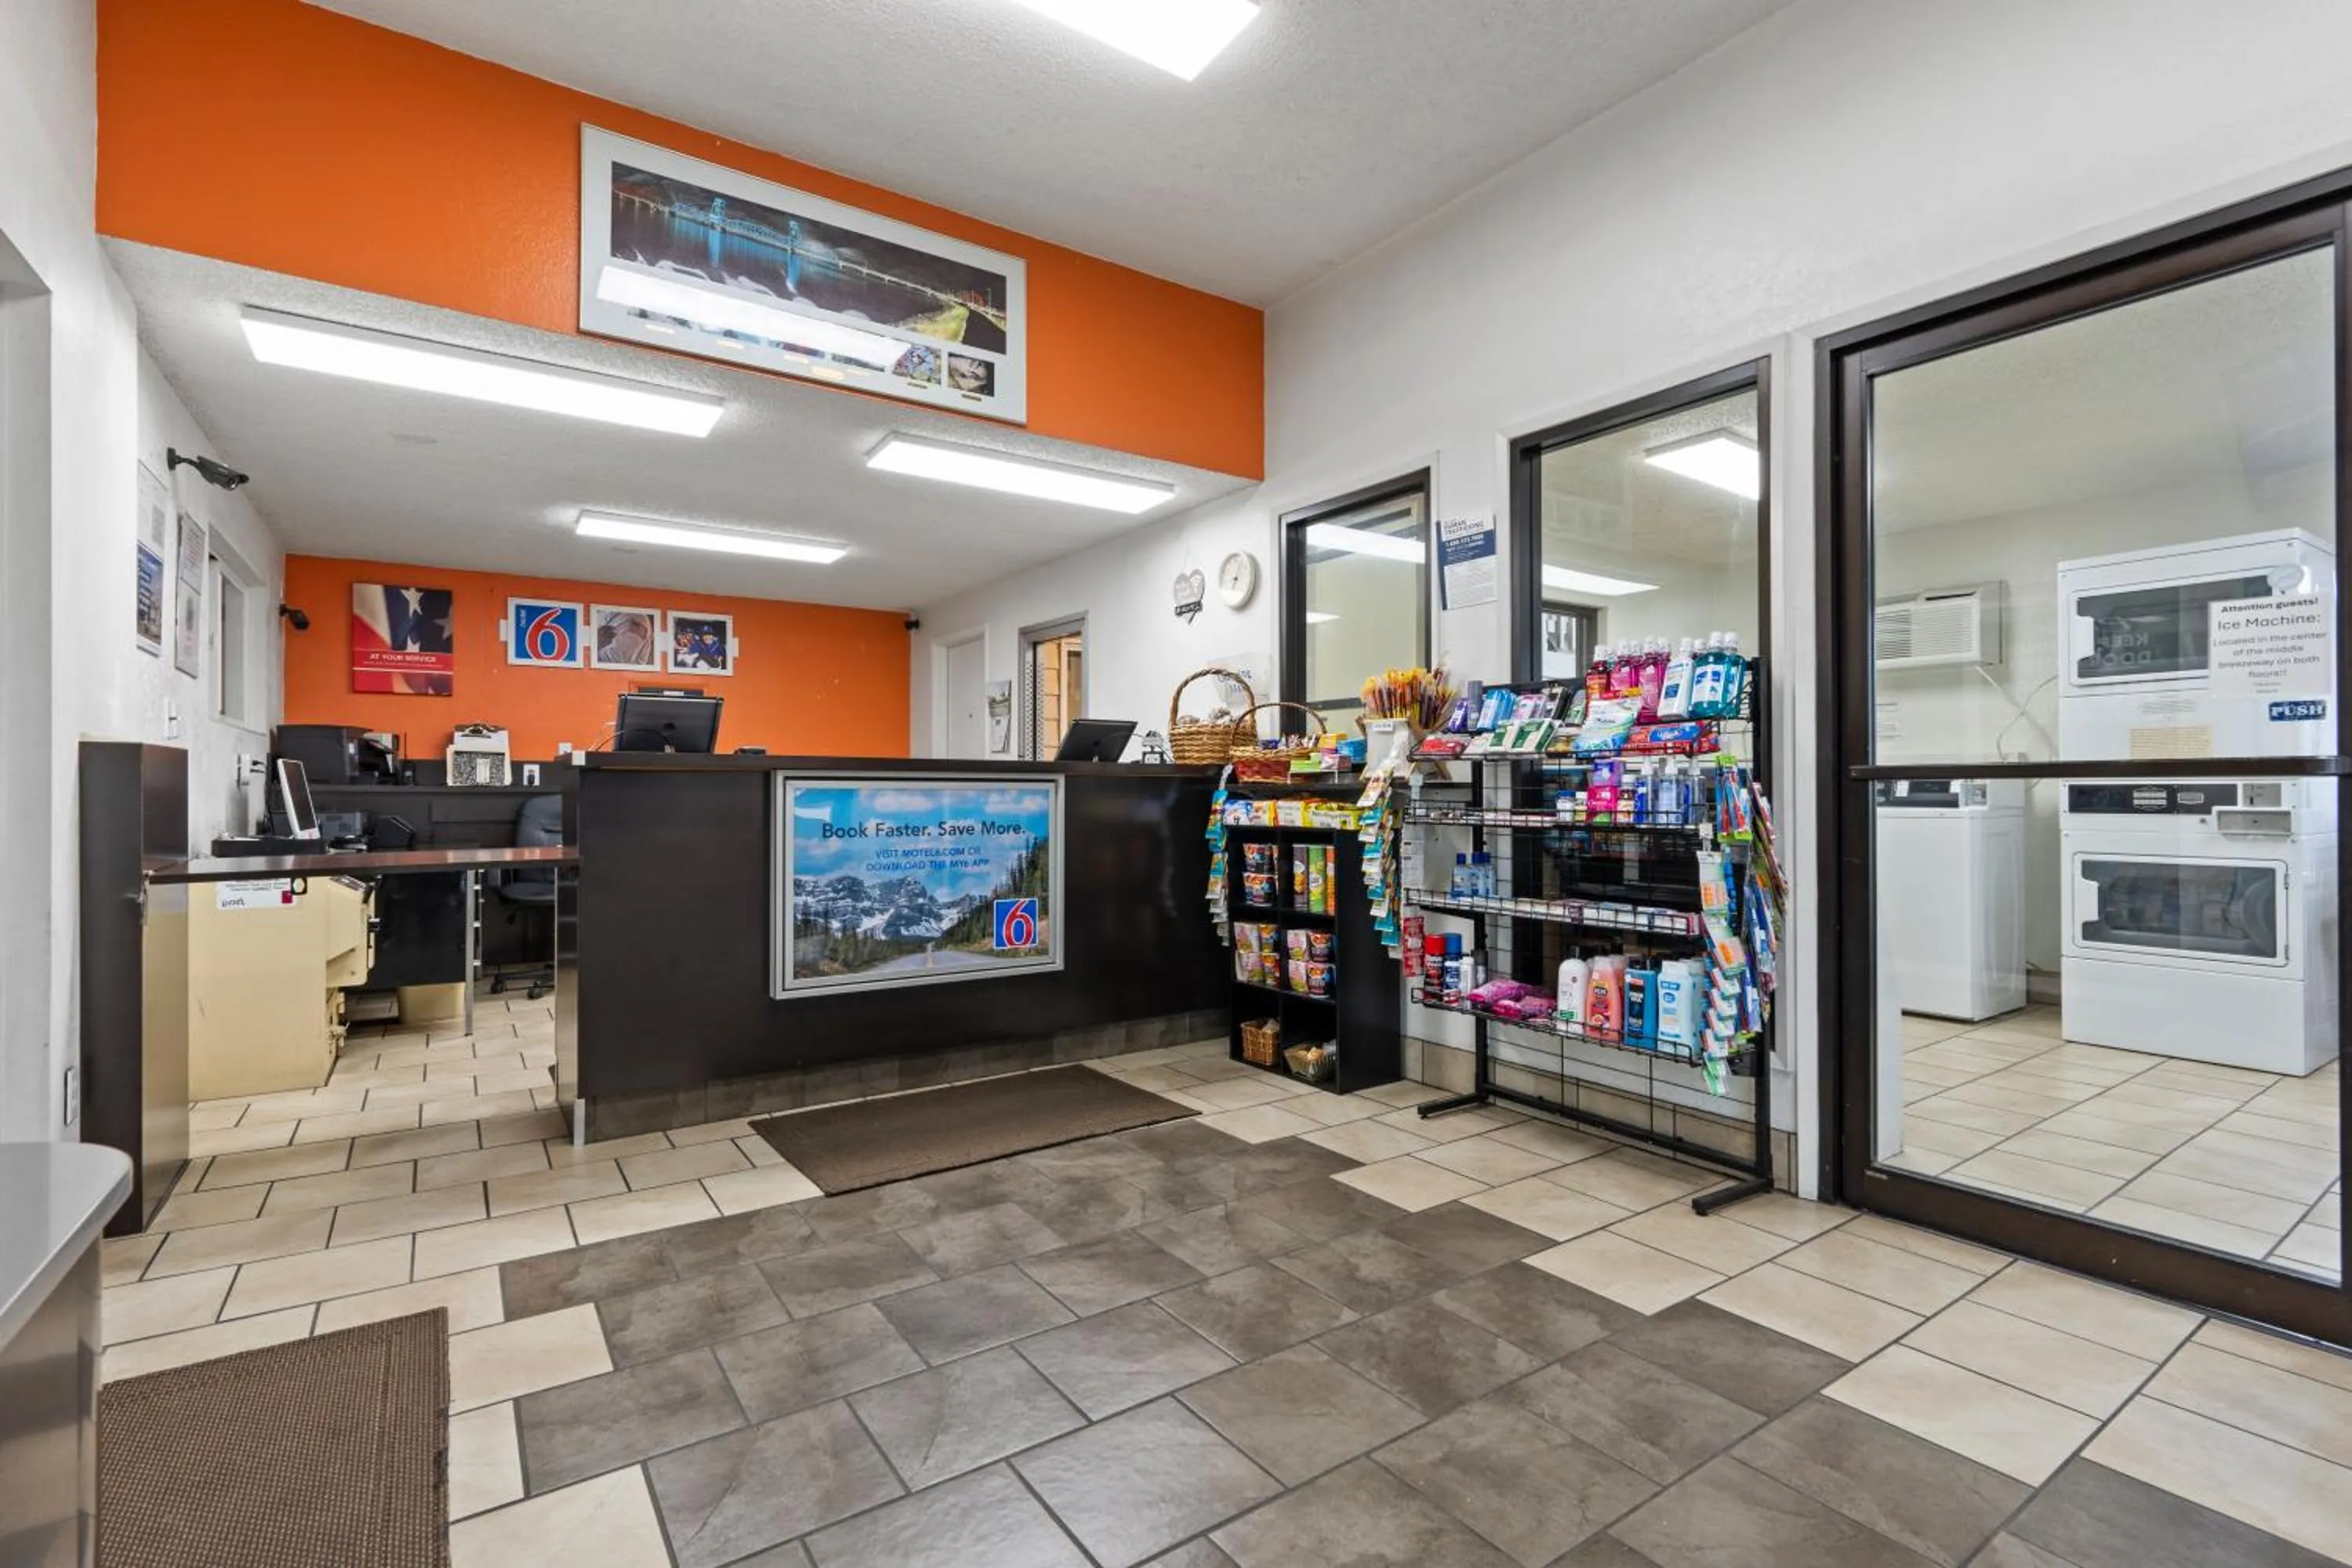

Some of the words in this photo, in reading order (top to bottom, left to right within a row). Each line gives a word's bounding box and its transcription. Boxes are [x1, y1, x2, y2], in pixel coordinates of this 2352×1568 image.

[2221, 602, 2273, 613] Attention
[2275, 597, 2318, 609] guests!
[2218, 620, 2241, 630] Ice
[2245, 614, 2321, 628] Machine:
[525, 608, 569, 662] 6
[2213, 637, 2256, 647] Located
[2270, 633, 2288, 642] the
[2290, 632, 2327, 641] center
[382, 653, 405, 662] YOUR
[2246, 648, 2263, 656] the
[2265, 645, 2304, 655] middle
[2293, 655, 2320, 665] both
[2270, 704, 2323, 717] PUSH
[822, 823, 869, 838] Book
[875, 822, 931, 837] Faster.
[938, 822, 975, 837] Save
[981, 821, 1026, 835] More.
[875, 848, 898, 859] VISIT
[902, 847, 965, 858] MOTEL6.COM
[967, 846, 982, 855] OR
[866, 862, 926, 872] DOWNLOAD
[929, 861, 946, 870] THE
[971, 859, 990, 868] APP
[1003, 898, 1034, 949] 6
